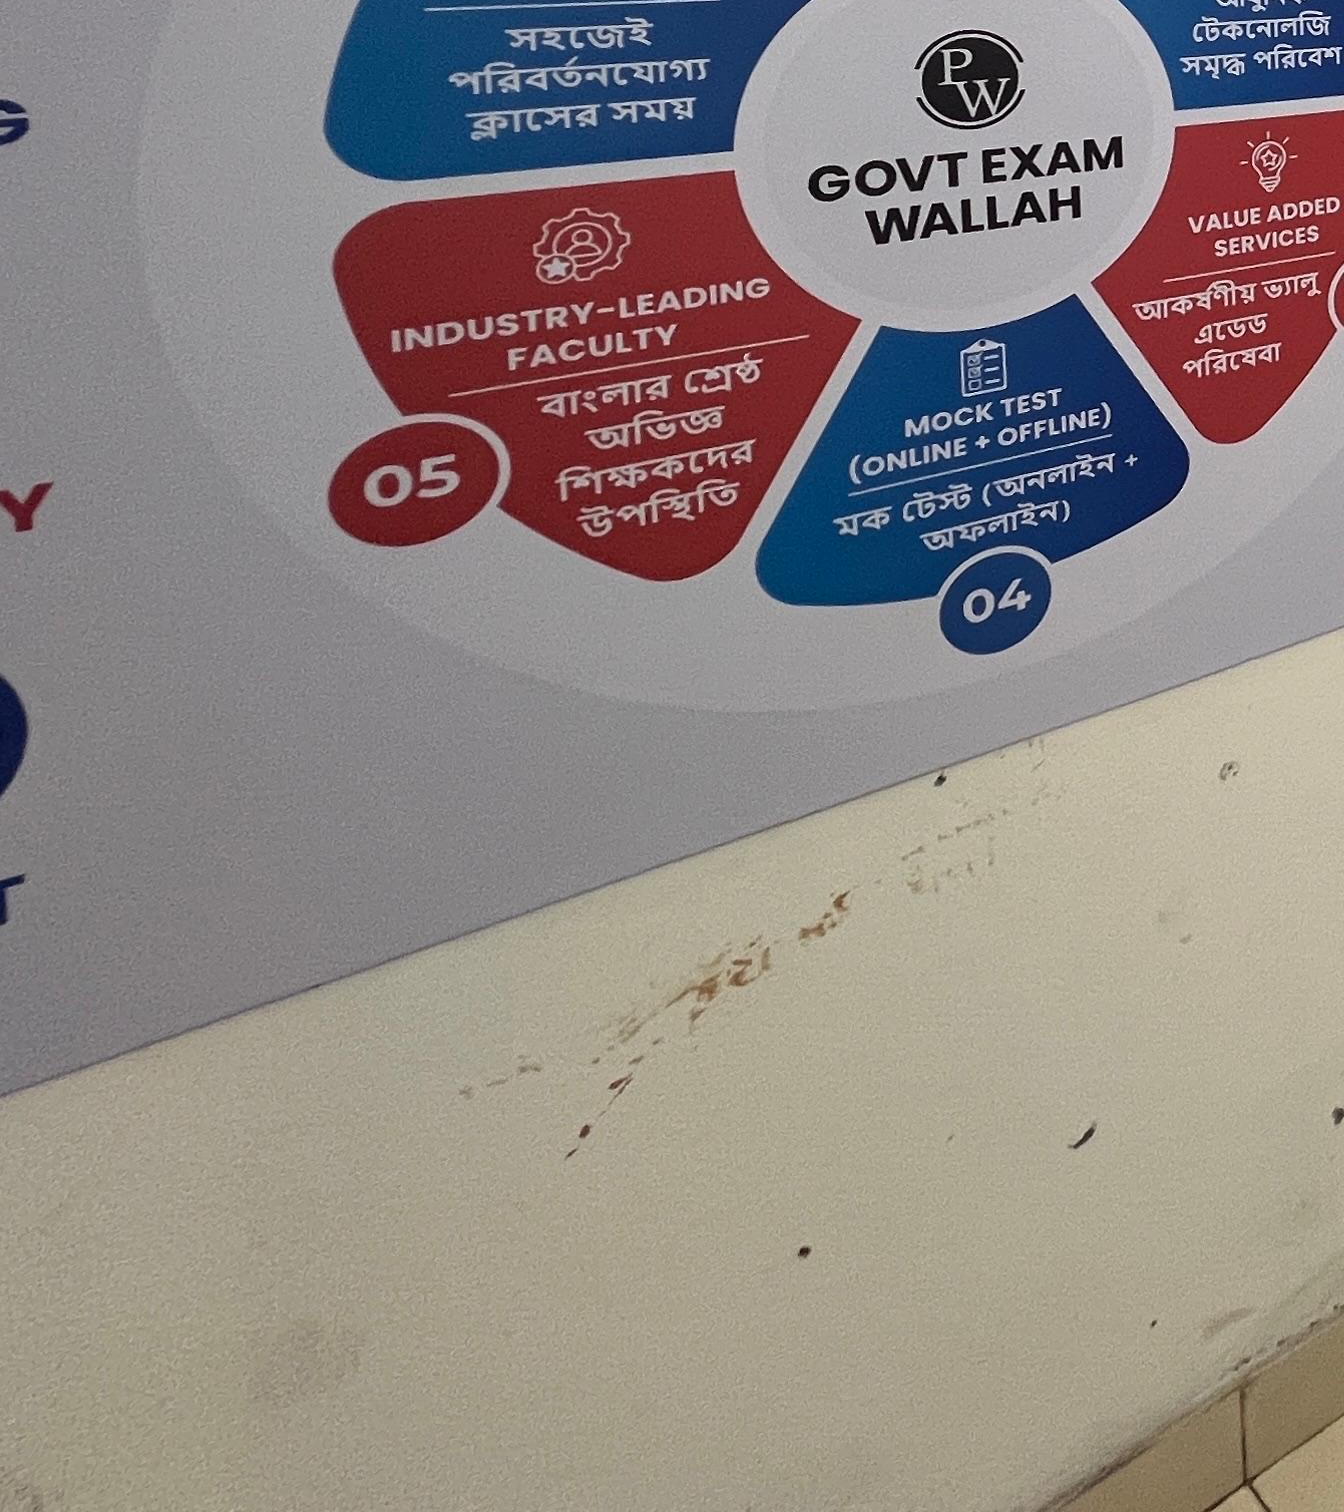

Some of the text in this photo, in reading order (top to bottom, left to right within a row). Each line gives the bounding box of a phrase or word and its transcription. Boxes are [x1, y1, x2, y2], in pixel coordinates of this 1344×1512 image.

[505, 16, 654, 51] সহজেই
[1192, 10, 1332, 42] টেকনোলজি
[448, 56, 712, 96] পরিবর্তনযোগ্য
[1180, 43, 1343, 80] সমৃদ্ধ পরিবেশ
[465, 95, 698, 143] ক্লাসের সময়
[807, 135, 1124, 202] GOVT EXAM
[864, 185, 1082, 245] WALLAH
[1188, 196, 1341, 235] VALUE ADDED
[1214, 225, 1320, 257] SERVICES
[390, 277, 771, 353] INDUSTRY-LEADING
[1132, 271, 1322, 322] আকর্ষণীয় ভ্যালু
[507, 324, 678, 371] FACULTY
[1194, 312, 1268, 345] এডেড
[1182, 341, 1282, 379] পরিষেবা
[537, 353, 763, 419] বাংলার শ্রেষ্ঠ
[584, 406, 726, 452] অভিজ্ঞ
[903, 388, 1064, 439] MOCK TEST
[847, 402, 1112, 486] (ONLINE OFFLINE)
[362, 453, 461, 508] 05
[555, 439, 757, 503] শিক্ষকদের
[832, 452, 1116, 538] মক টেস্ট (অনলাইন
[576, 481, 740, 538] উপস্থিতি
[919, 499, 1072, 552] অফলাইন)
[962, 578, 1033, 625] 04
